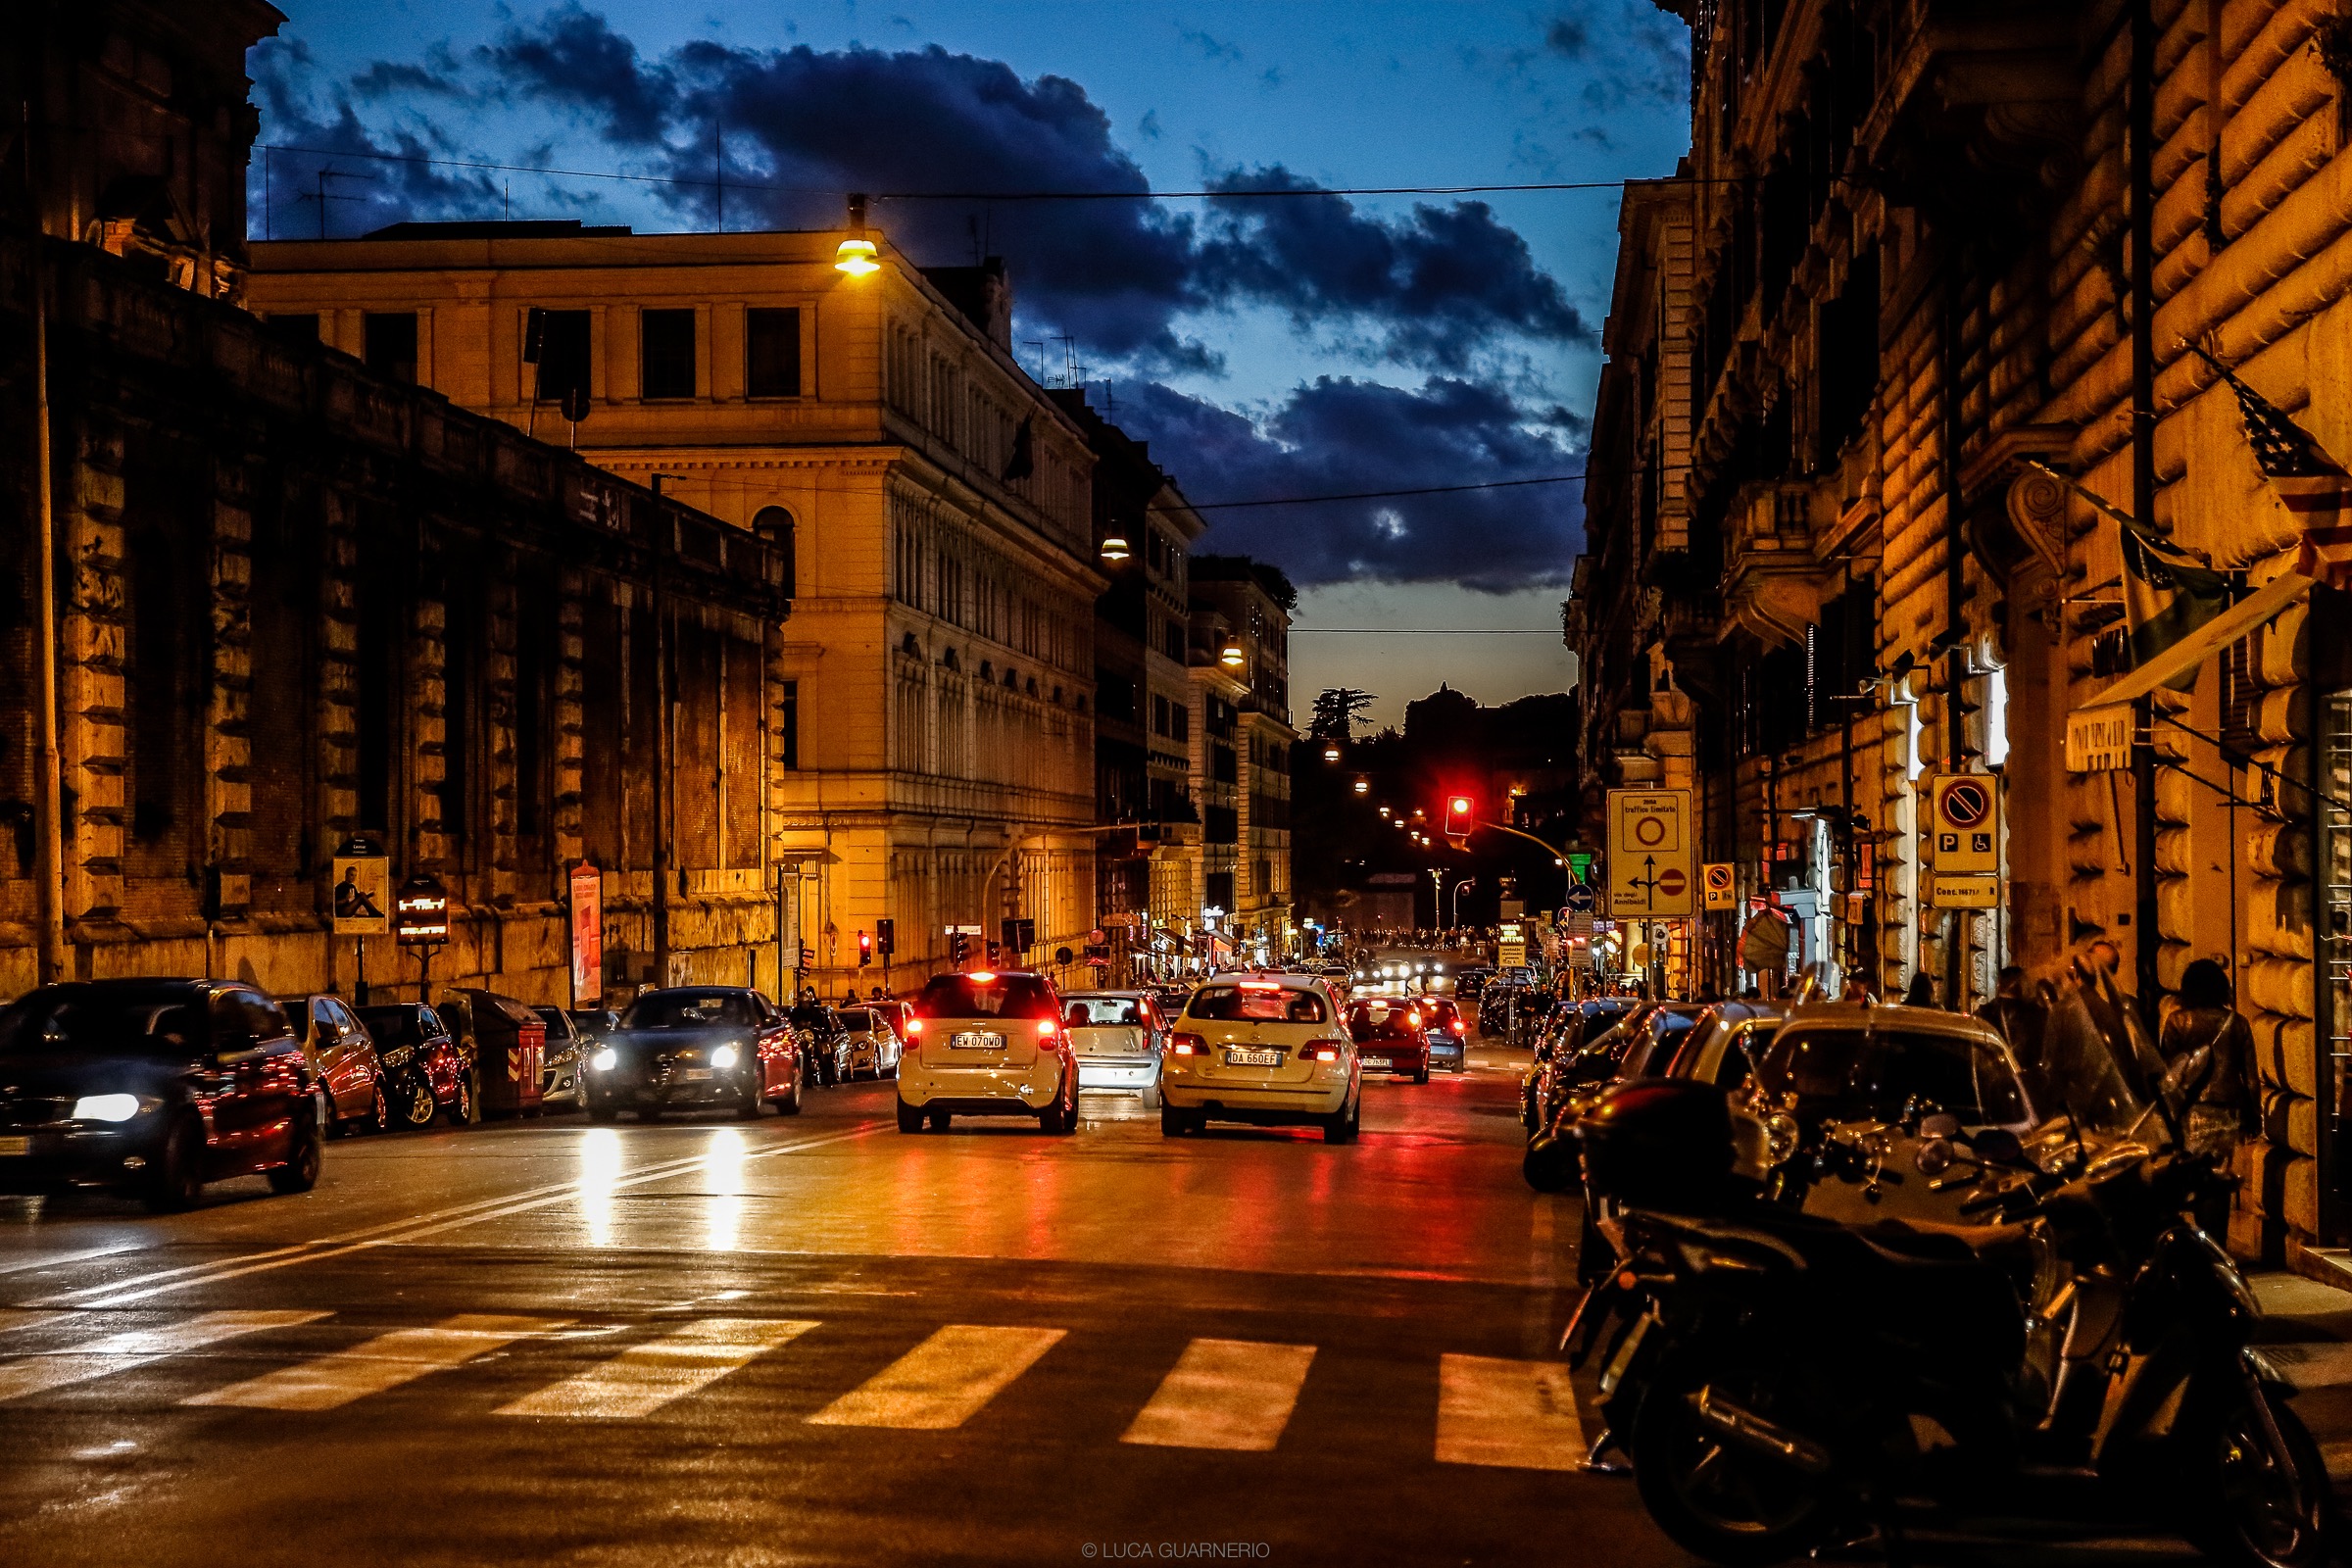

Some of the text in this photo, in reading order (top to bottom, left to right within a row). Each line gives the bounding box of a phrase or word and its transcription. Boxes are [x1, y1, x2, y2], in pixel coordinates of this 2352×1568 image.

[1943, 835, 1955, 851] P
[1936, 887, 1958, 896] Conc.
[956, 1036, 968, 1047] EW
[1232, 1053, 1276, 1064] DA 660EF
